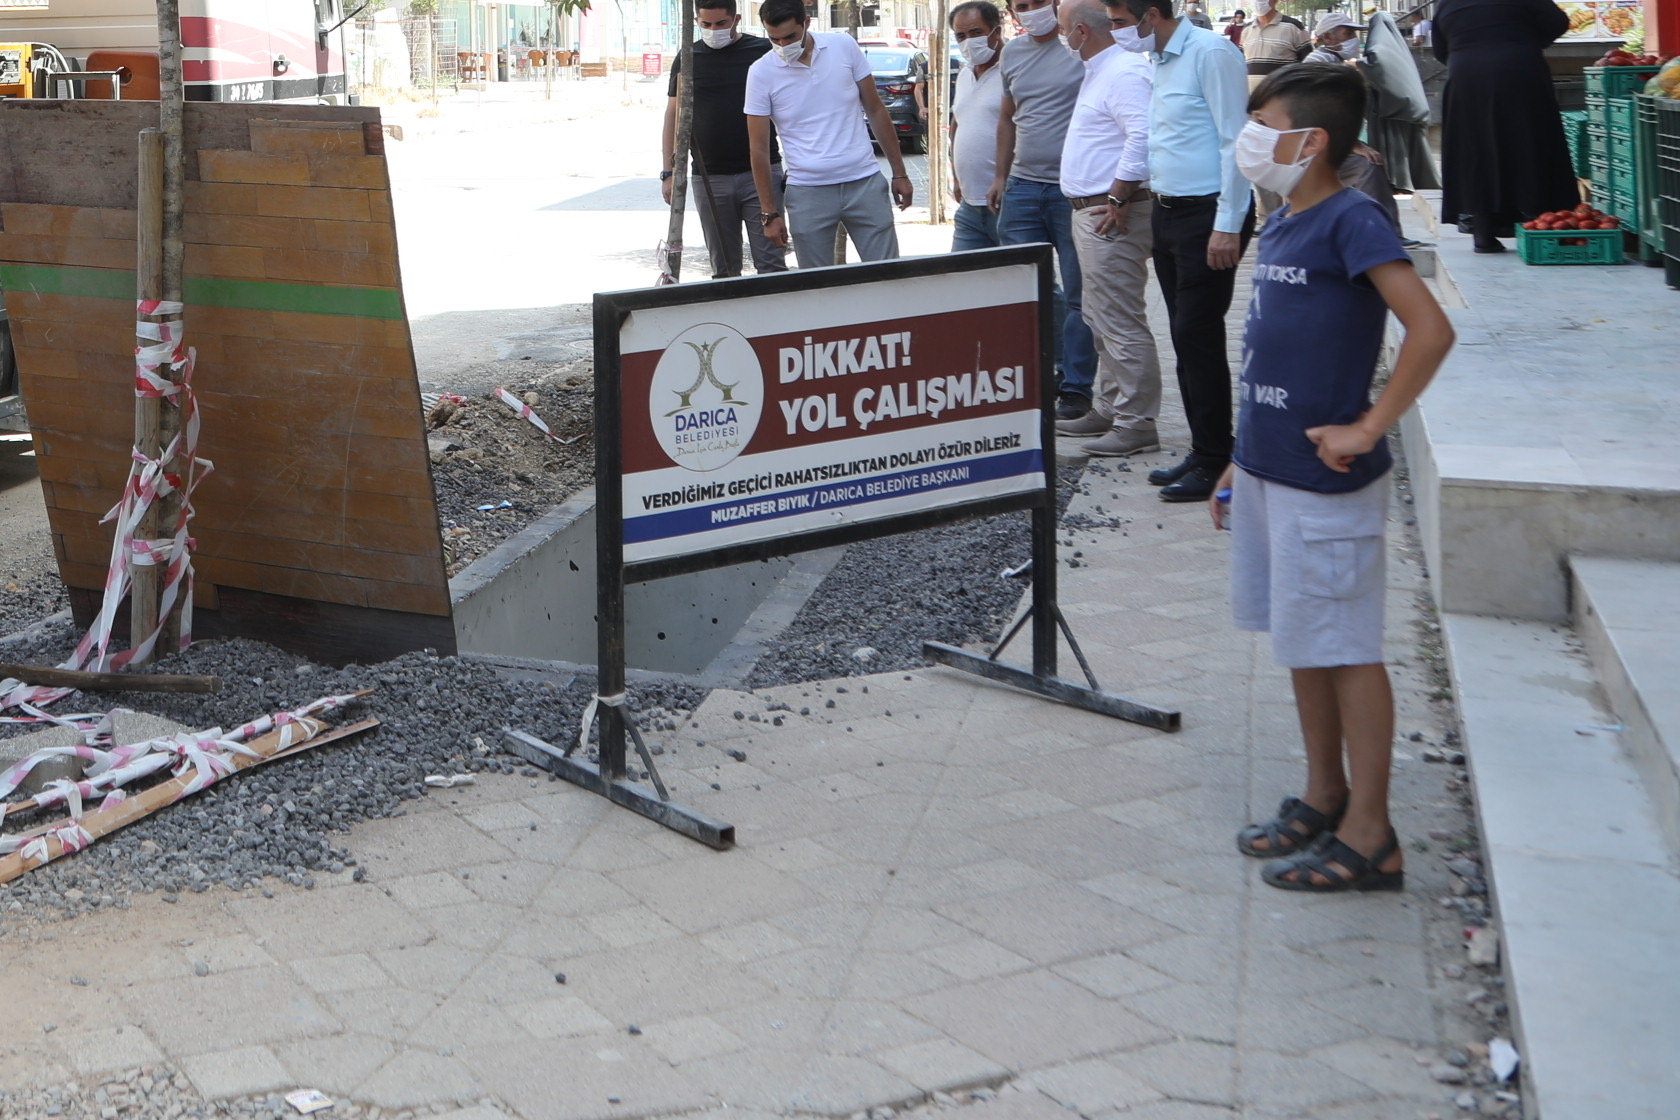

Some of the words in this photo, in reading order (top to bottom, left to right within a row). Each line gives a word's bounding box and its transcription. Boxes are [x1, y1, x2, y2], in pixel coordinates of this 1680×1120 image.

[779, 331, 911, 384] DİKKAT!
[675, 407, 738, 432] DARICA
[779, 393, 846, 435] YOL
[853, 366, 1024, 430] ÇALIŞMASI
[1254, 383, 1288, 410] VAR
[675, 426, 739, 444] BELEDİYESİ
[642, 482, 725, 510] VERDİĞİMİZ
[728, 472, 772, 496] GEÇİCİ
[775, 456, 887, 488] RAHATSIZLIKTAN
[890, 448, 935, 468] DOLAYI
[938, 441, 972, 460] ÖZÜR
[974, 432, 1021, 454] DİLERİZ
[711, 500, 776, 524] MUZAFFER
[778, 494, 810, 511] BIYIK
[820, 485, 864, 505] DARICA
[866, 475, 920, 496] BELEDİYE
[921, 466, 969, 486] BAŞKANI
